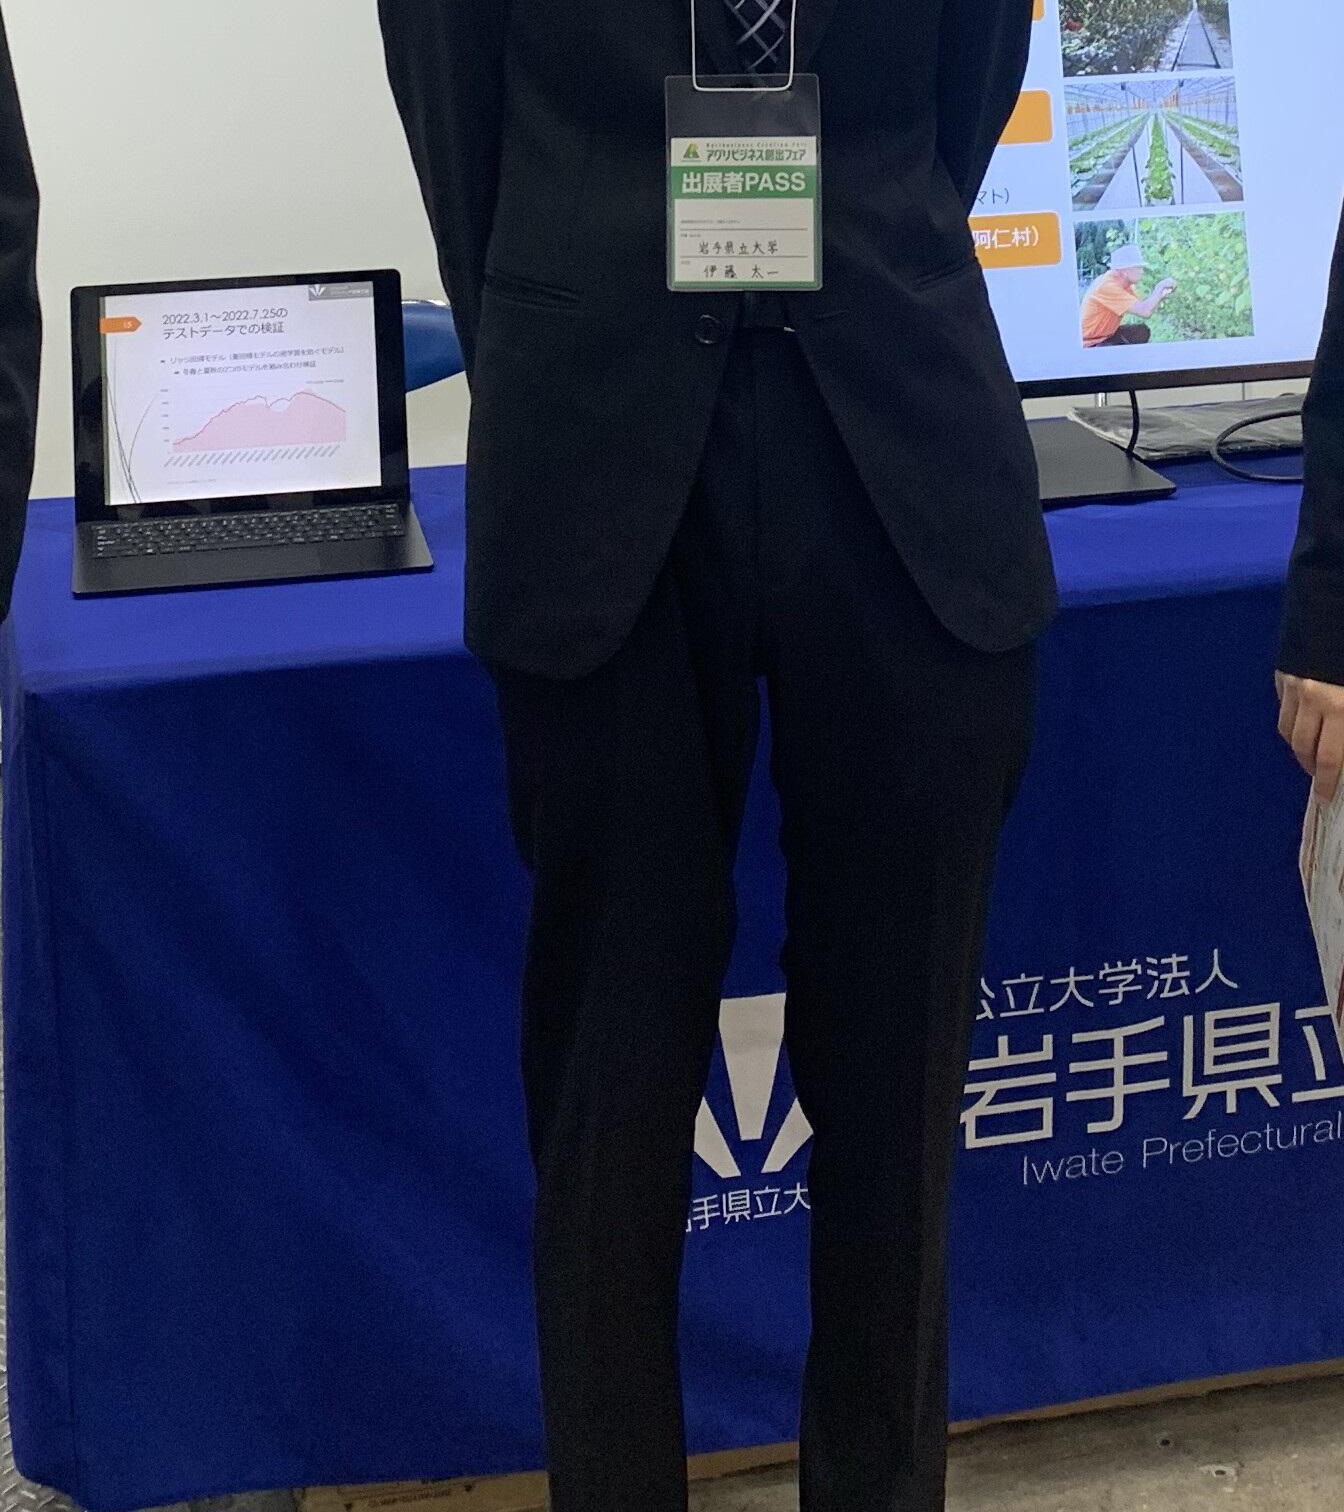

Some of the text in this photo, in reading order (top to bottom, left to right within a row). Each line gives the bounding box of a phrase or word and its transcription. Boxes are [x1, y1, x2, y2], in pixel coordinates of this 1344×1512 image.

[706, 148, 806, 162] アグリビジネス創出フェア
[682, 171, 806, 194] 出展者PASS
[698, 239, 779, 256] 岩手県立大学
[162, 321, 285, 341] テストデータでの検証
[1021, 1109, 1343, 1186] Iwate Prefectural
[685, 1182, 811, 1233] 手県立大
